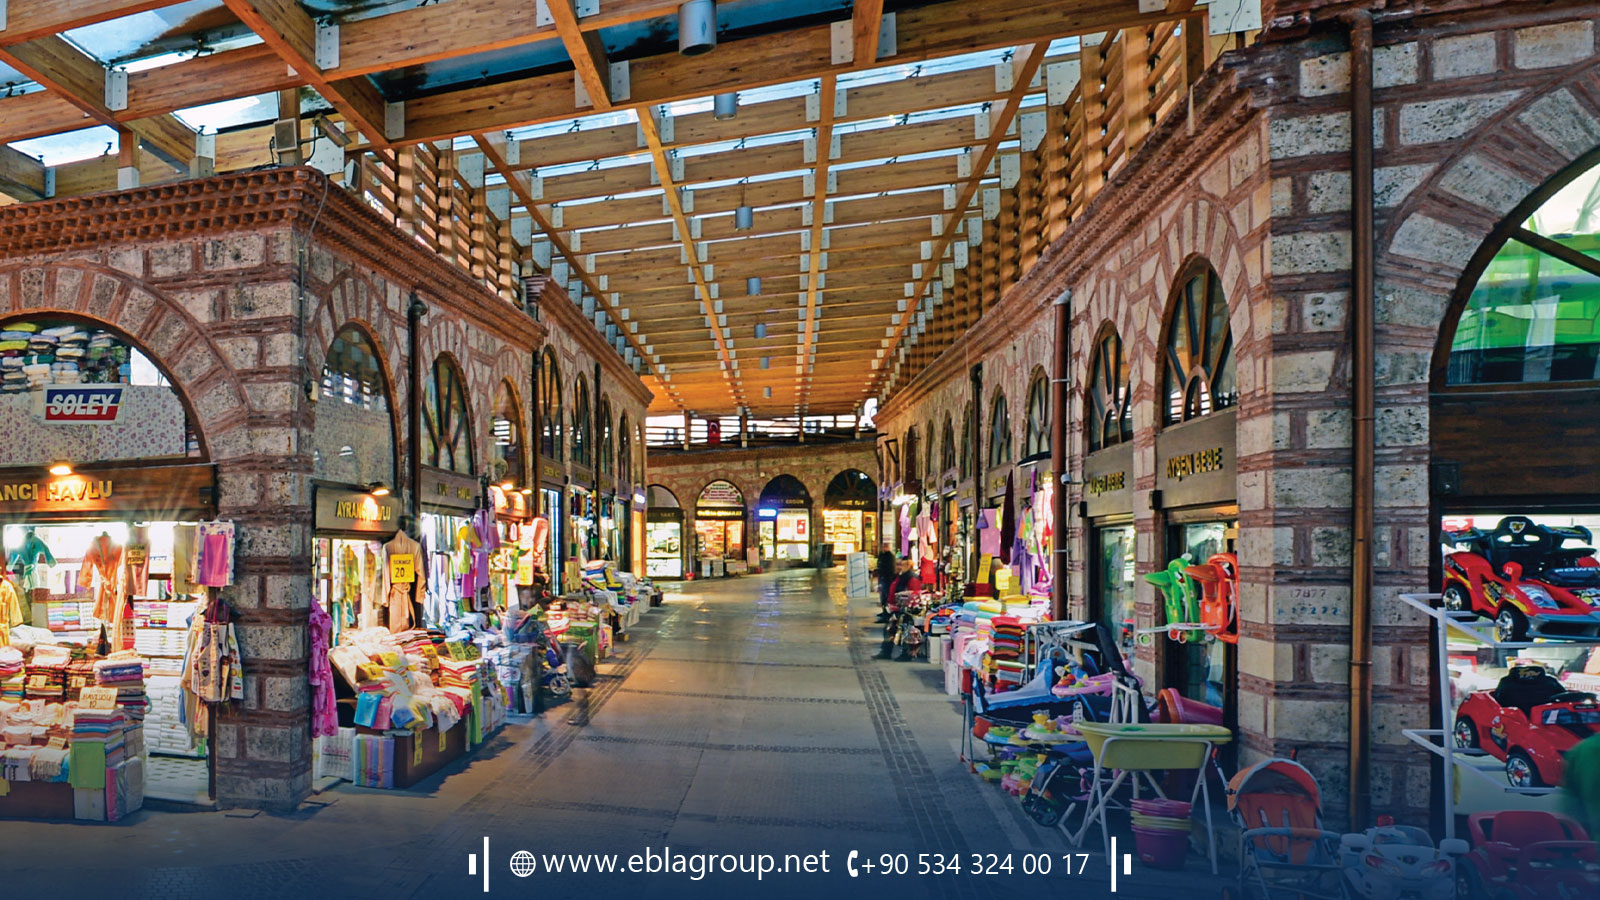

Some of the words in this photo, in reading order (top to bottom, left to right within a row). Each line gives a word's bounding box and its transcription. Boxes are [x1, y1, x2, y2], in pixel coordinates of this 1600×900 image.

[50, 393, 115, 416] SOLEY
[1194, 448, 1223, 473] BEBE
[46, 480, 113, 501] HAVLU
[395, 567, 405, 578] 20
